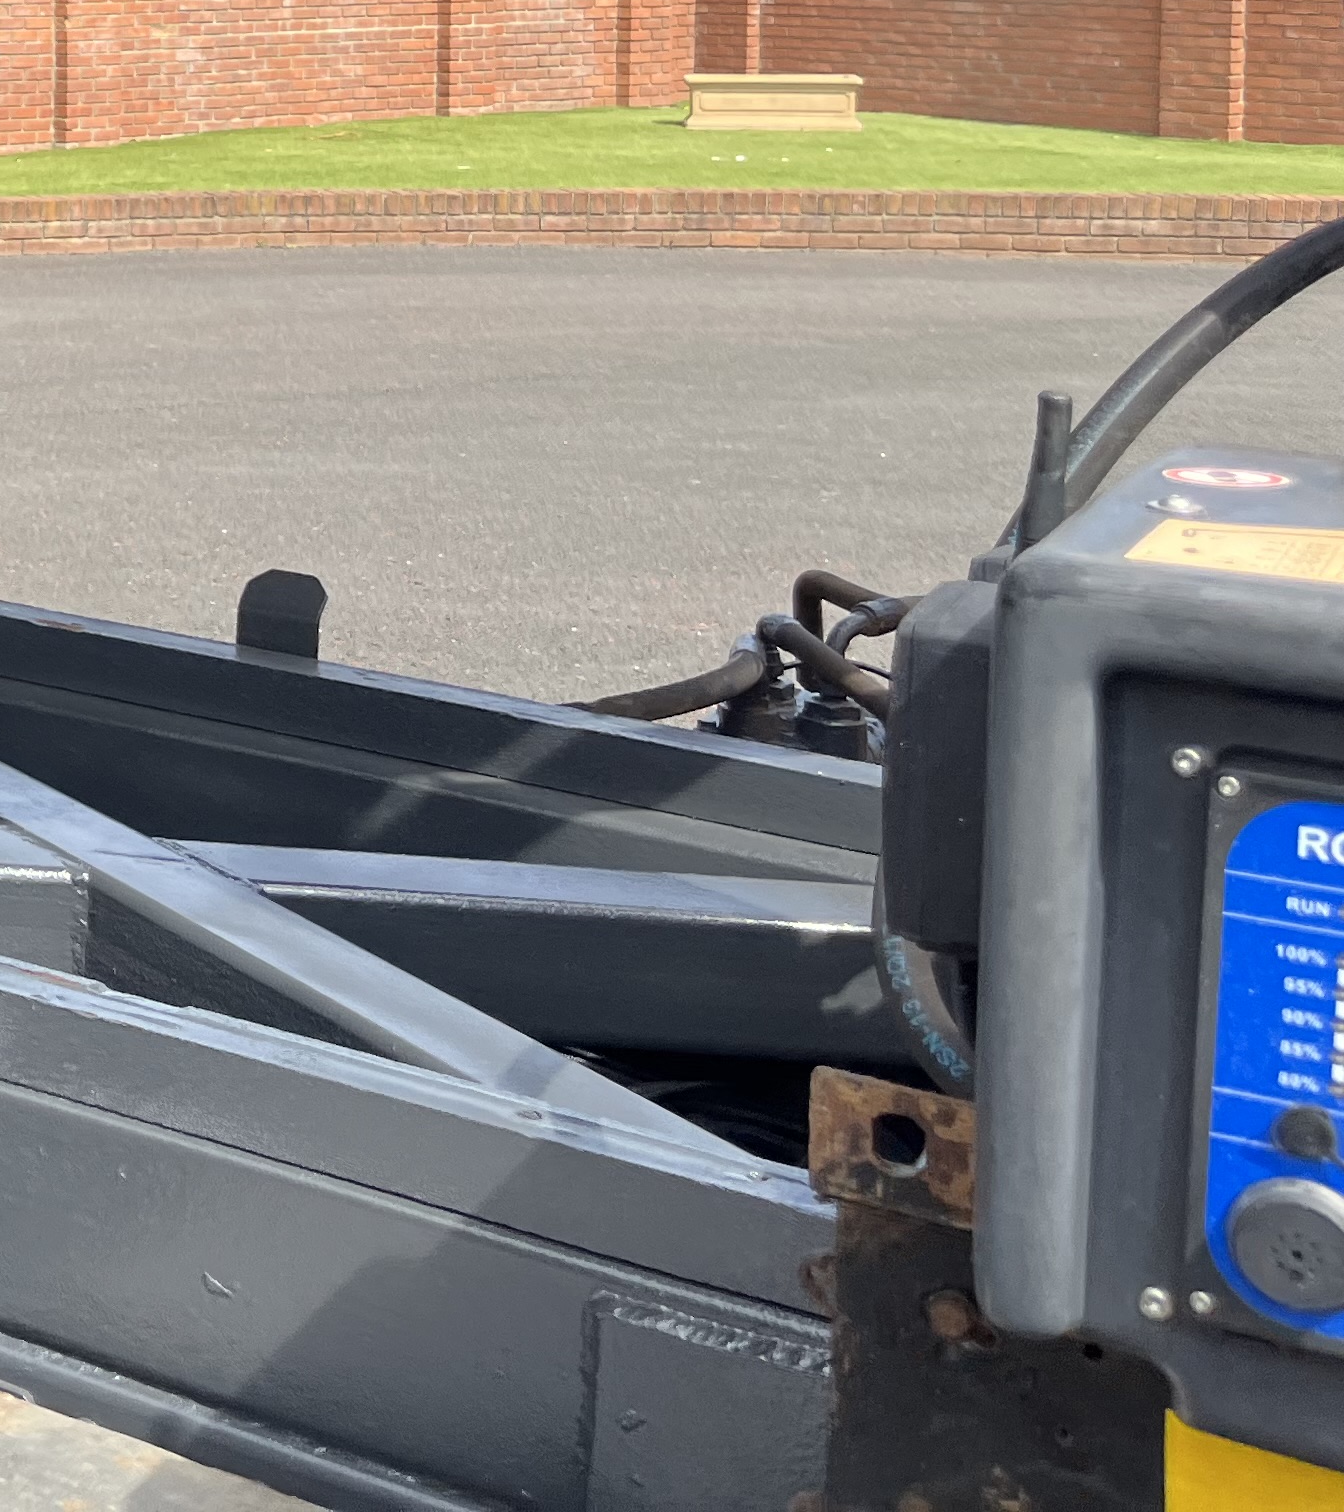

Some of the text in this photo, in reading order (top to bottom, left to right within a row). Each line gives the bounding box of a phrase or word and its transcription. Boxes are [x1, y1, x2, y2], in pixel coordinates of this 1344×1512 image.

[1285, 895, 1330, 918] RUN
[1275, 943, 1328, 967] 100%
[1283, 975, 1326, 999] 95%
[1281, 1007, 1324, 1031] 90%
[1279, 1039, 1322, 1063] 85%
[1277, 1070, 1320, 1094] 80%
